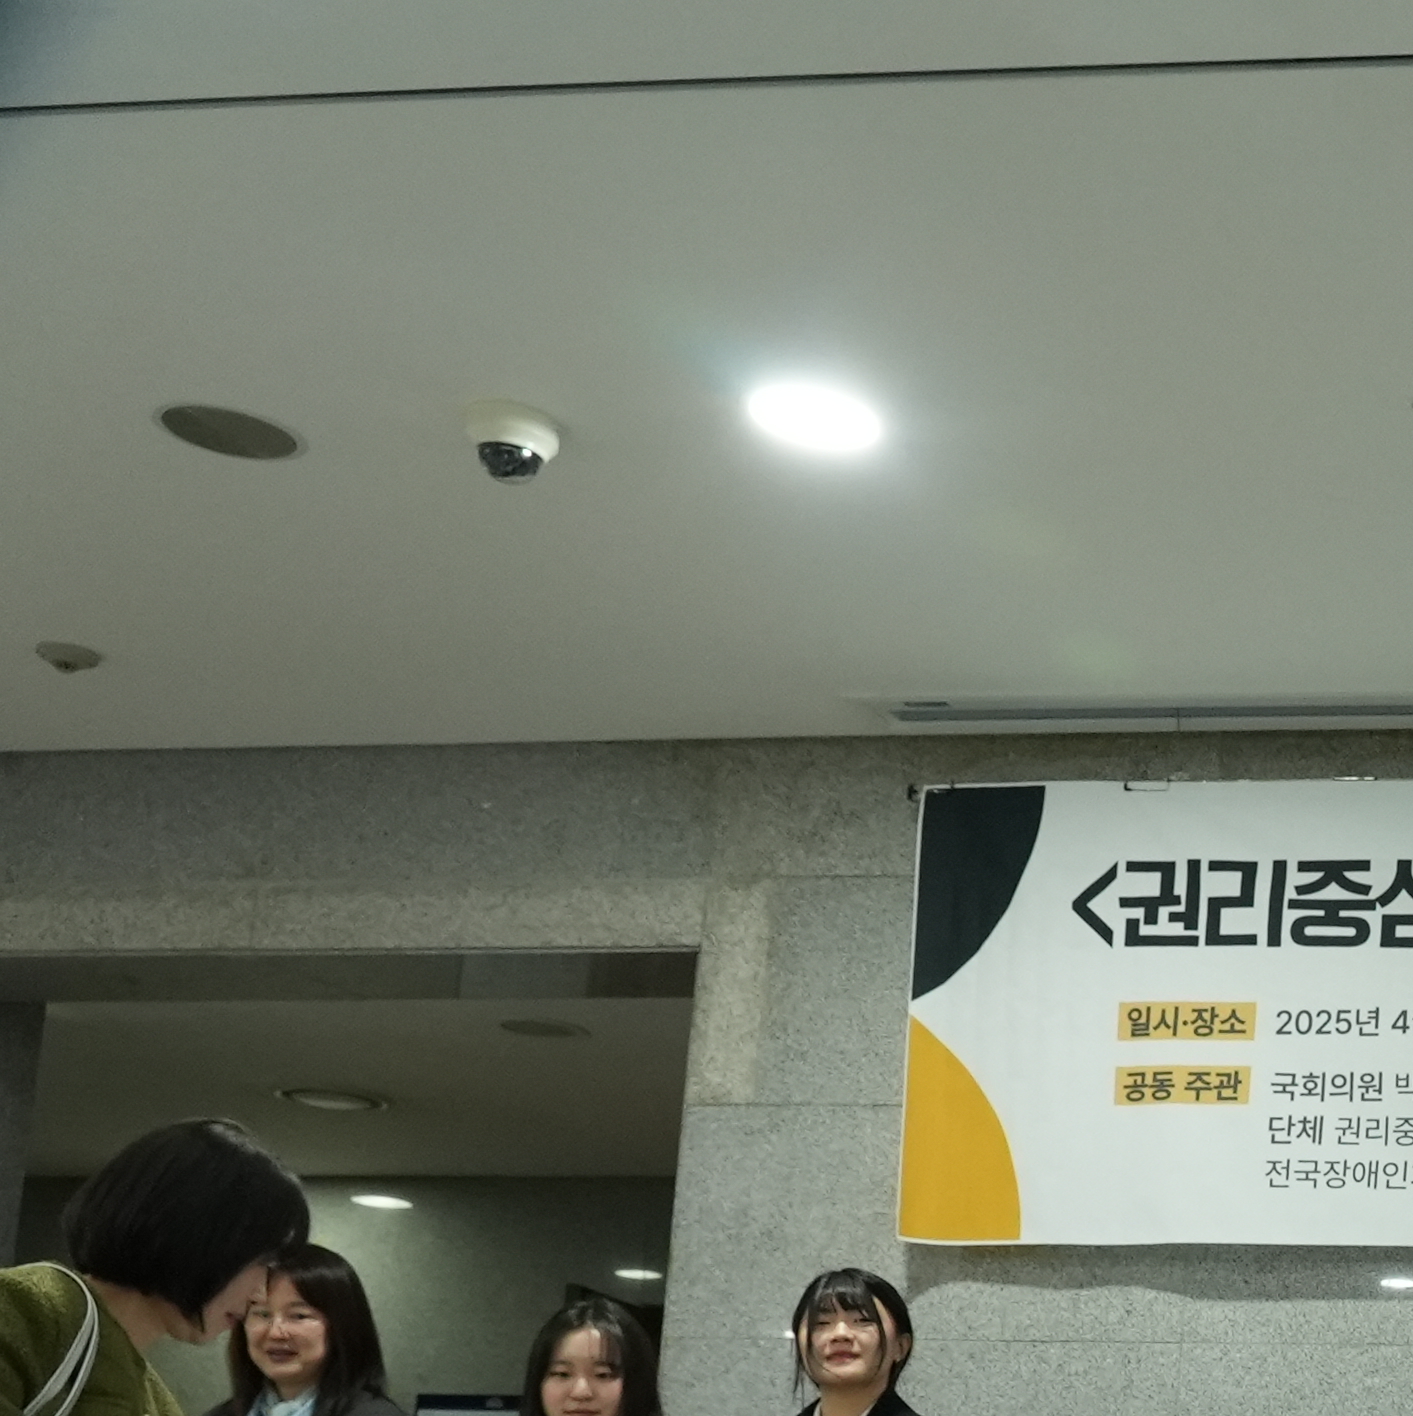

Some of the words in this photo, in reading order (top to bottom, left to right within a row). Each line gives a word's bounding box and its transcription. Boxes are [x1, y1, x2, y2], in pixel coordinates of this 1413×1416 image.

[1127, 1005, 1247, 1038] 일시·장소
[1275, 1007, 1381, 1039] 2025년
[1123, 1070, 1176, 1102] 공동
[1184, 1069, 1243, 1102] 주관
[1270, 1071, 1385, 1103] 국회의원
[1267, 1115, 1325, 1146] 단체
